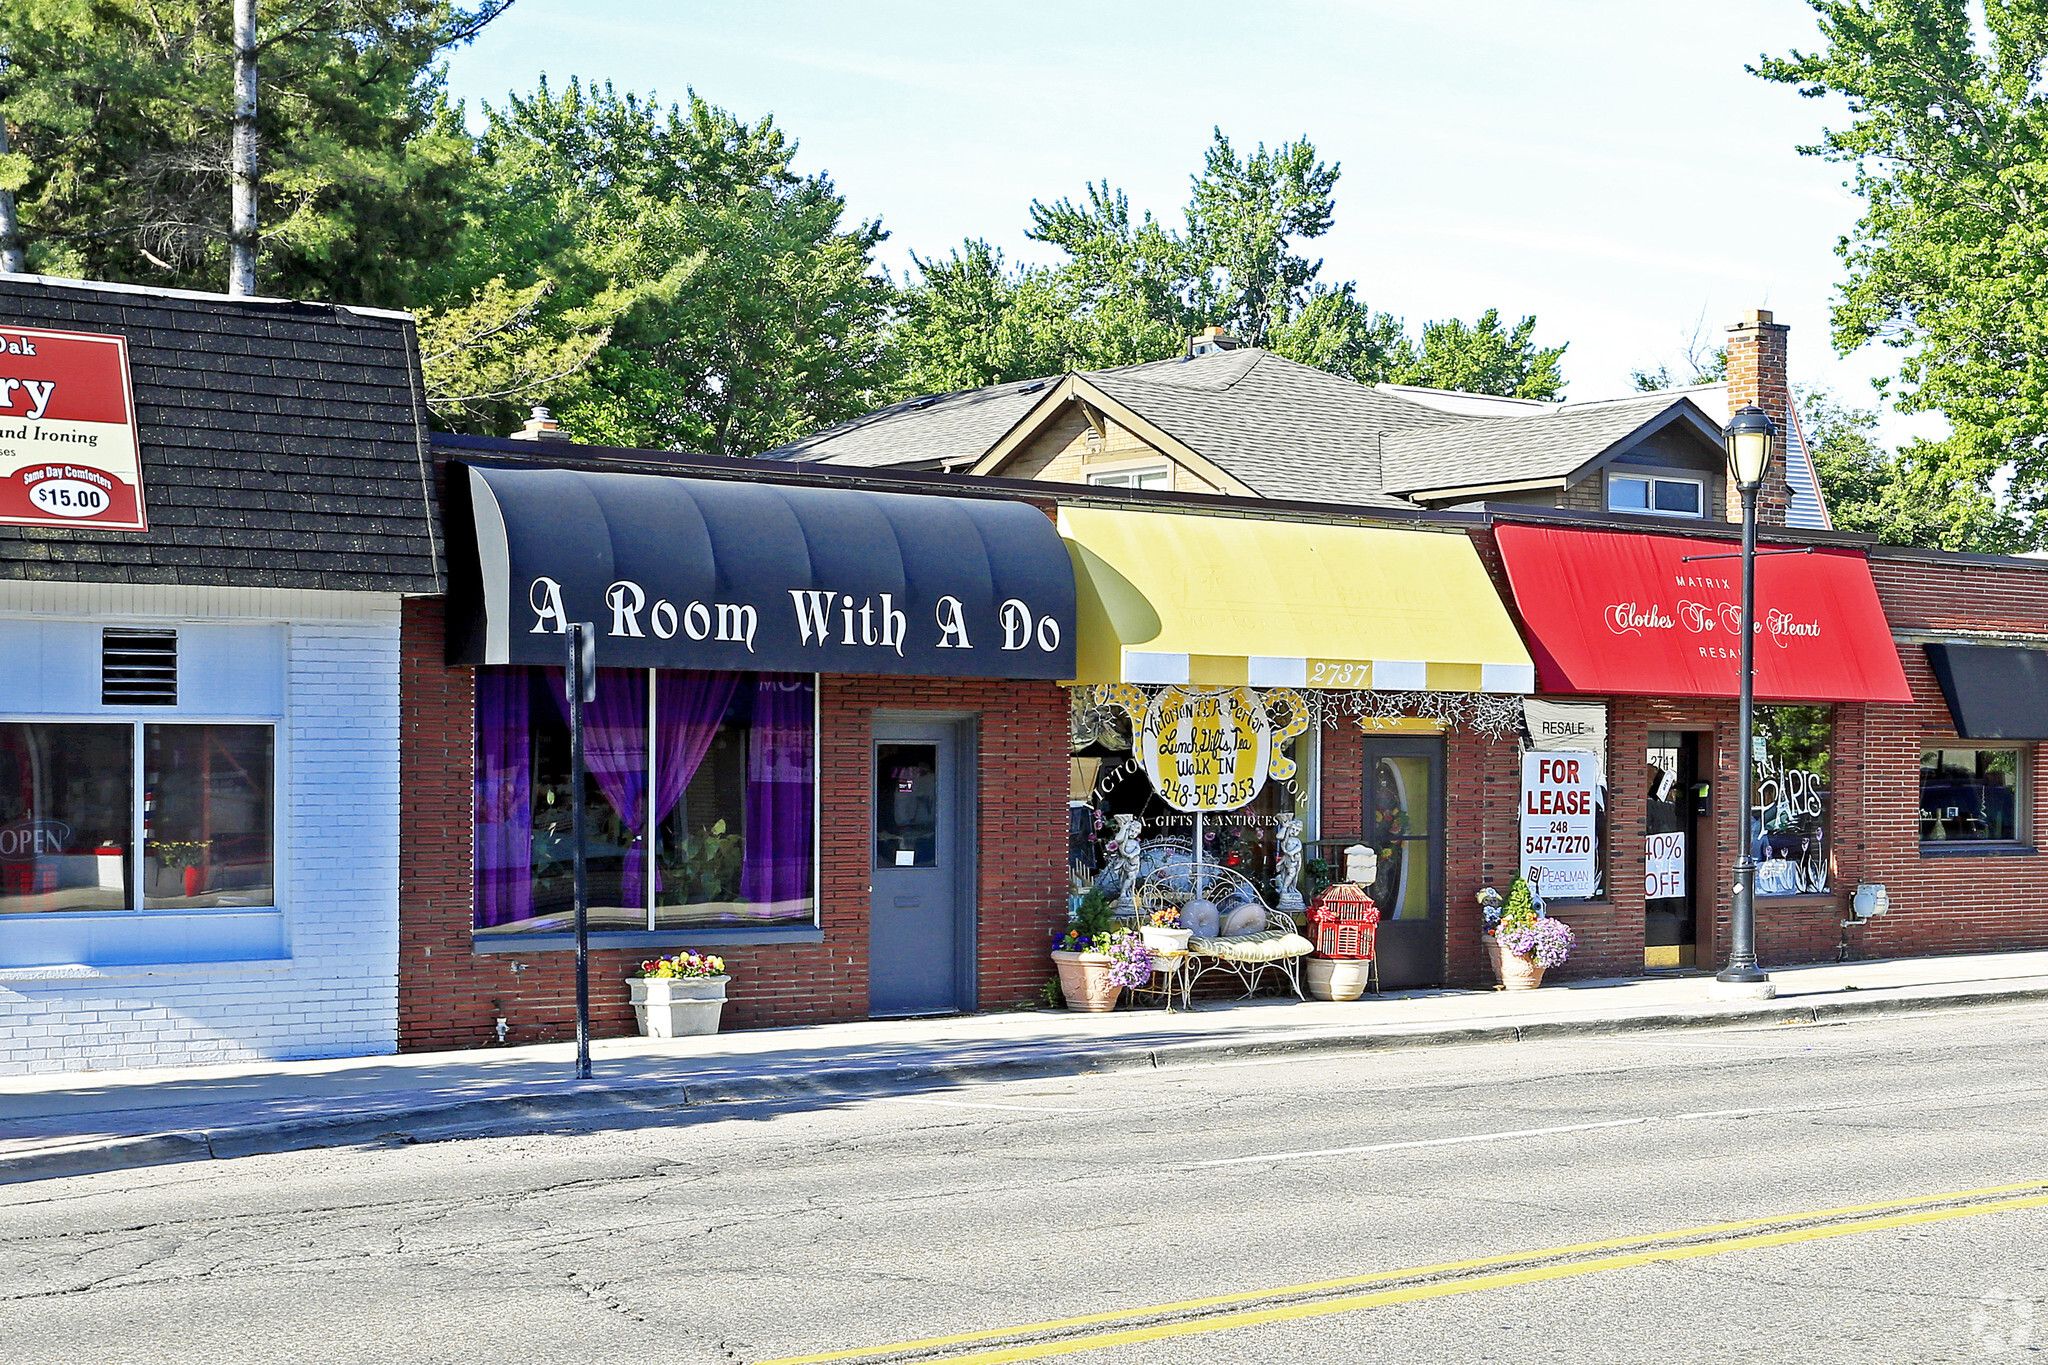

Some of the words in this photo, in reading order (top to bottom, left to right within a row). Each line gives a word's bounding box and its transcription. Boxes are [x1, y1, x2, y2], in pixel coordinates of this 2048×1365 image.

[34, 426, 98, 447] Ironing
[23, 469, 45, 485] Same
[45, 465, 63, 479] Day
[64, 465, 113, 490] Comforters
[38, 488, 101, 508] $15.00
[1675, 576, 1730, 590] MATRIX
[529, 576, 568, 634] A
[605, 580, 758, 654] Room
[787, 589, 906, 658] With
[935, 595, 974, 649] A
[999, 598, 1061, 652] Do
[1604, 602, 1676, 637] Clothes
[1677, 599, 1717, 634] To
[1717, 602, 1762, 635] Te
[1766, 608, 1820, 648] Heart
[1698, 646, 1755, 660] RESA
[1309, 662, 1370, 687] 2737
[1230, 727, 1251, 750] Tea
[1542, 721, 1585, 735] RESALE
[1216, 757, 1235, 775] IN
[1539, 759, 1580, 784] FOR
[1650, 755, 1674, 771] 2741
[1160, 777, 1255, 806] 248-542-5253
[1527, 790, 1591, 815] LEASE
[1155, 815, 1193, 827] GIFTS
[1202, 815, 1211, 827] &
[1215, 815, 1279, 828] ANTIQUES
[1549, 821, 1568, 833] 248
[0, 829, 62, 854] OPEN
[1526, 835, 1590, 854] 547-7270
[1645, 872, 1680, 896] OFF
